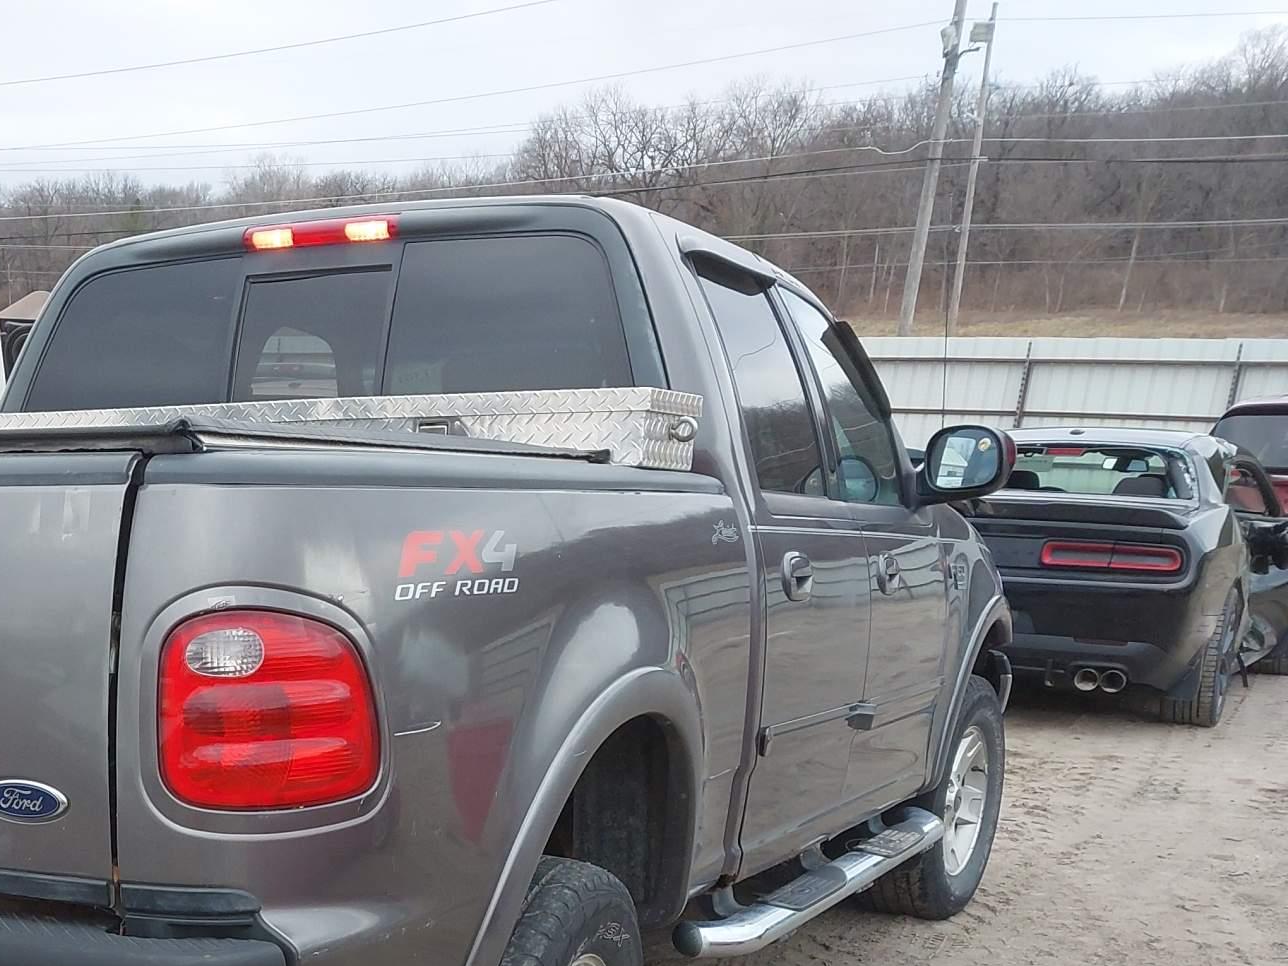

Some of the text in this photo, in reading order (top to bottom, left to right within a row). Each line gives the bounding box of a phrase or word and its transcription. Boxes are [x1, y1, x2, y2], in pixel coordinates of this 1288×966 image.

[398, 528, 518, 578] FX4
[394, 577, 520, 601] OFF ROAD
[0, 786, 44, 812] Ford
